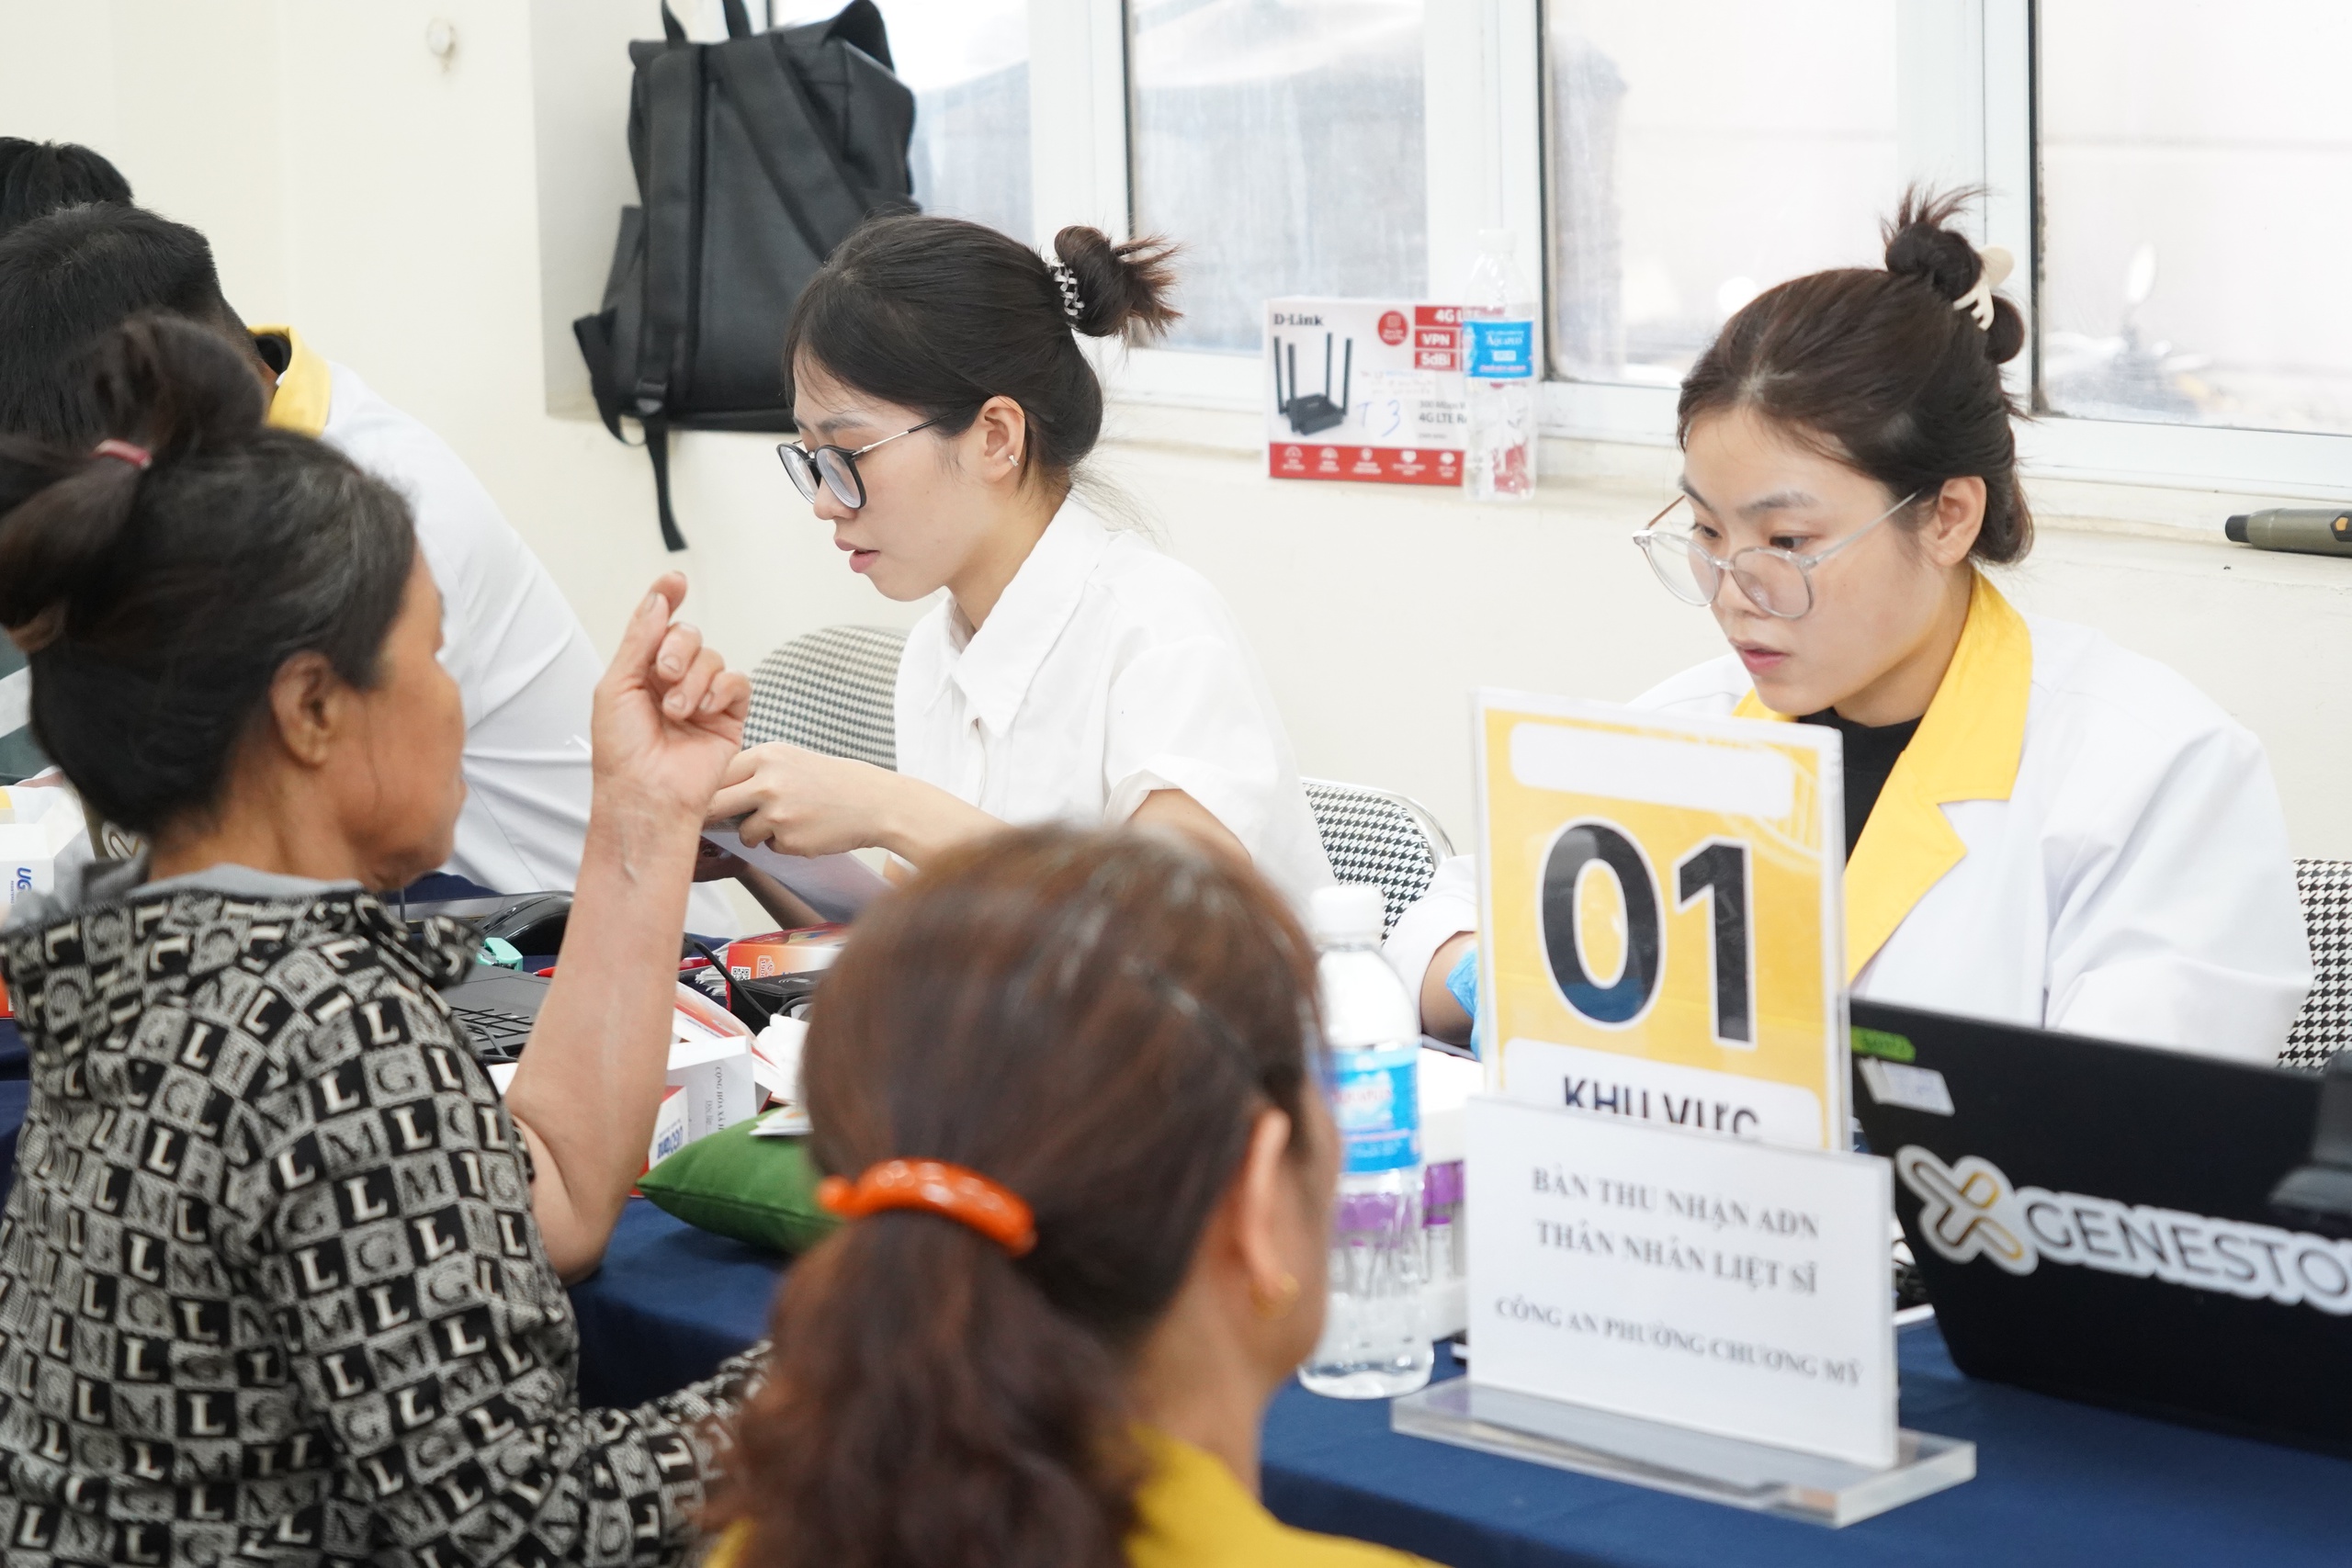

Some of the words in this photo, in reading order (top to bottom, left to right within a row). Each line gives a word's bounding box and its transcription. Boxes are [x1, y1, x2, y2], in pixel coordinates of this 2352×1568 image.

[1273, 312, 1324, 326] D-Link
[1434, 309, 1454, 322] 4G
[1421, 333, 1451, 346] VPN
[1382, 400, 1401, 437] 3
[1419, 412, 1433, 423] 4G
[1436, 412, 1453, 423] LTE
[1540, 822, 1754, 1044] 01
[1532, 1162, 1589, 1198] BÀN
[1599, 1178, 1657, 1213] THU
[1756, 1207, 1818, 1239] ADN
[1535, 1217, 1615, 1257] THÂN
[1623, 1234, 1705, 1271] NHÂN
[1712, 1251, 1782, 1291] LIỆT
[1496, 1292, 1562, 1329] CÔNG
[1568, 1311, 1599, 1333] AN
